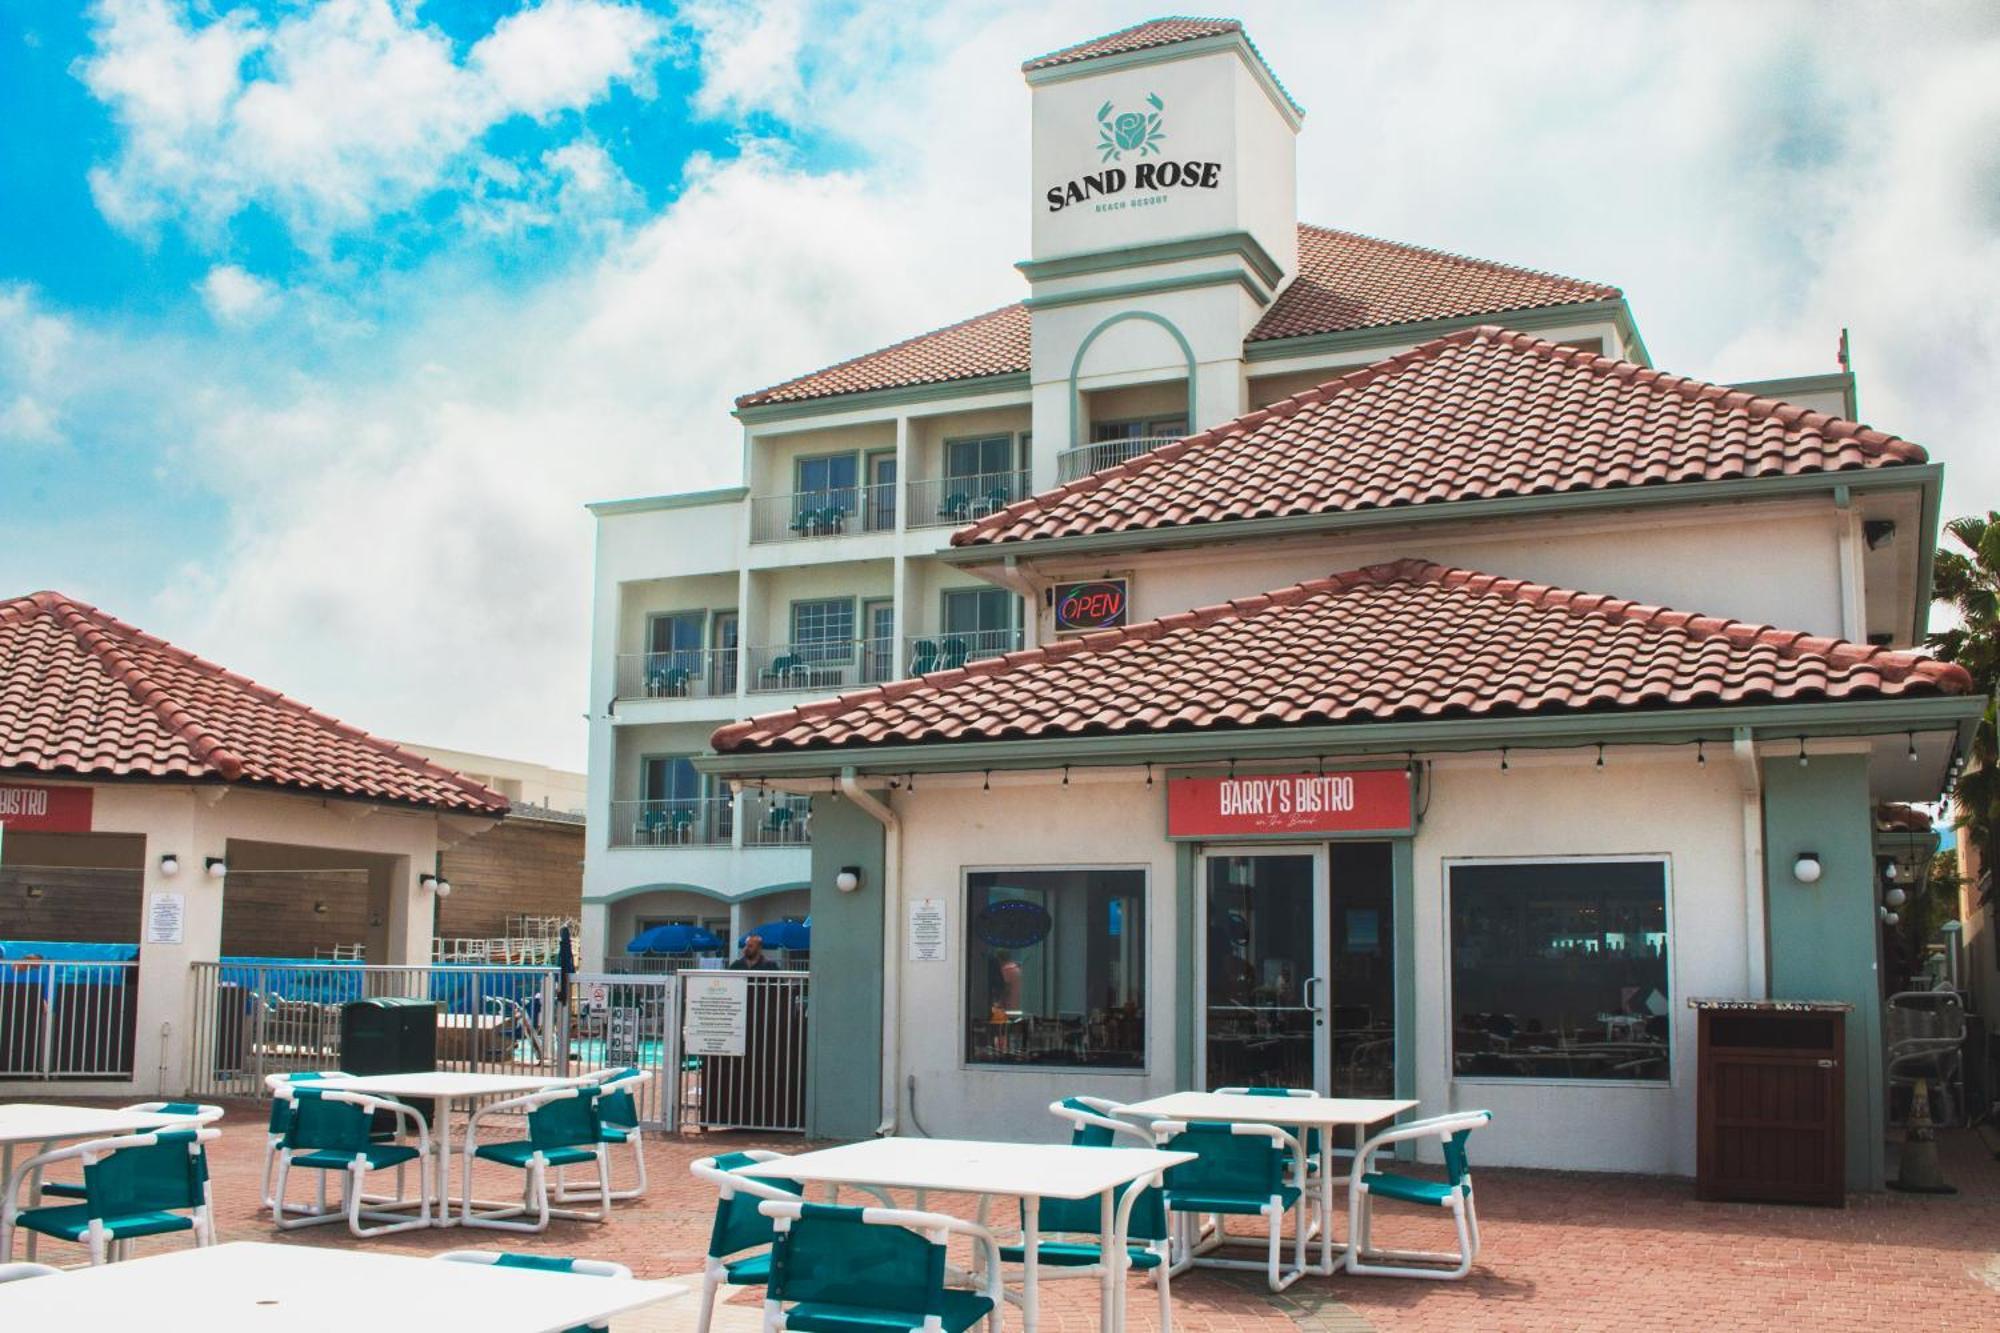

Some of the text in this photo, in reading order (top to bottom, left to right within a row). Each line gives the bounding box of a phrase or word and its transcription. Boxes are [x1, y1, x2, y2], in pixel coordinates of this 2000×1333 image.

[1047, 161, 1221, 213] SAND ROSE
[1095, 201, 1126, 213] BEACH
[1062, 592, 1120, 619] OPEN
[1220, 776, 1355, 816] BARRY'S BISTRO
